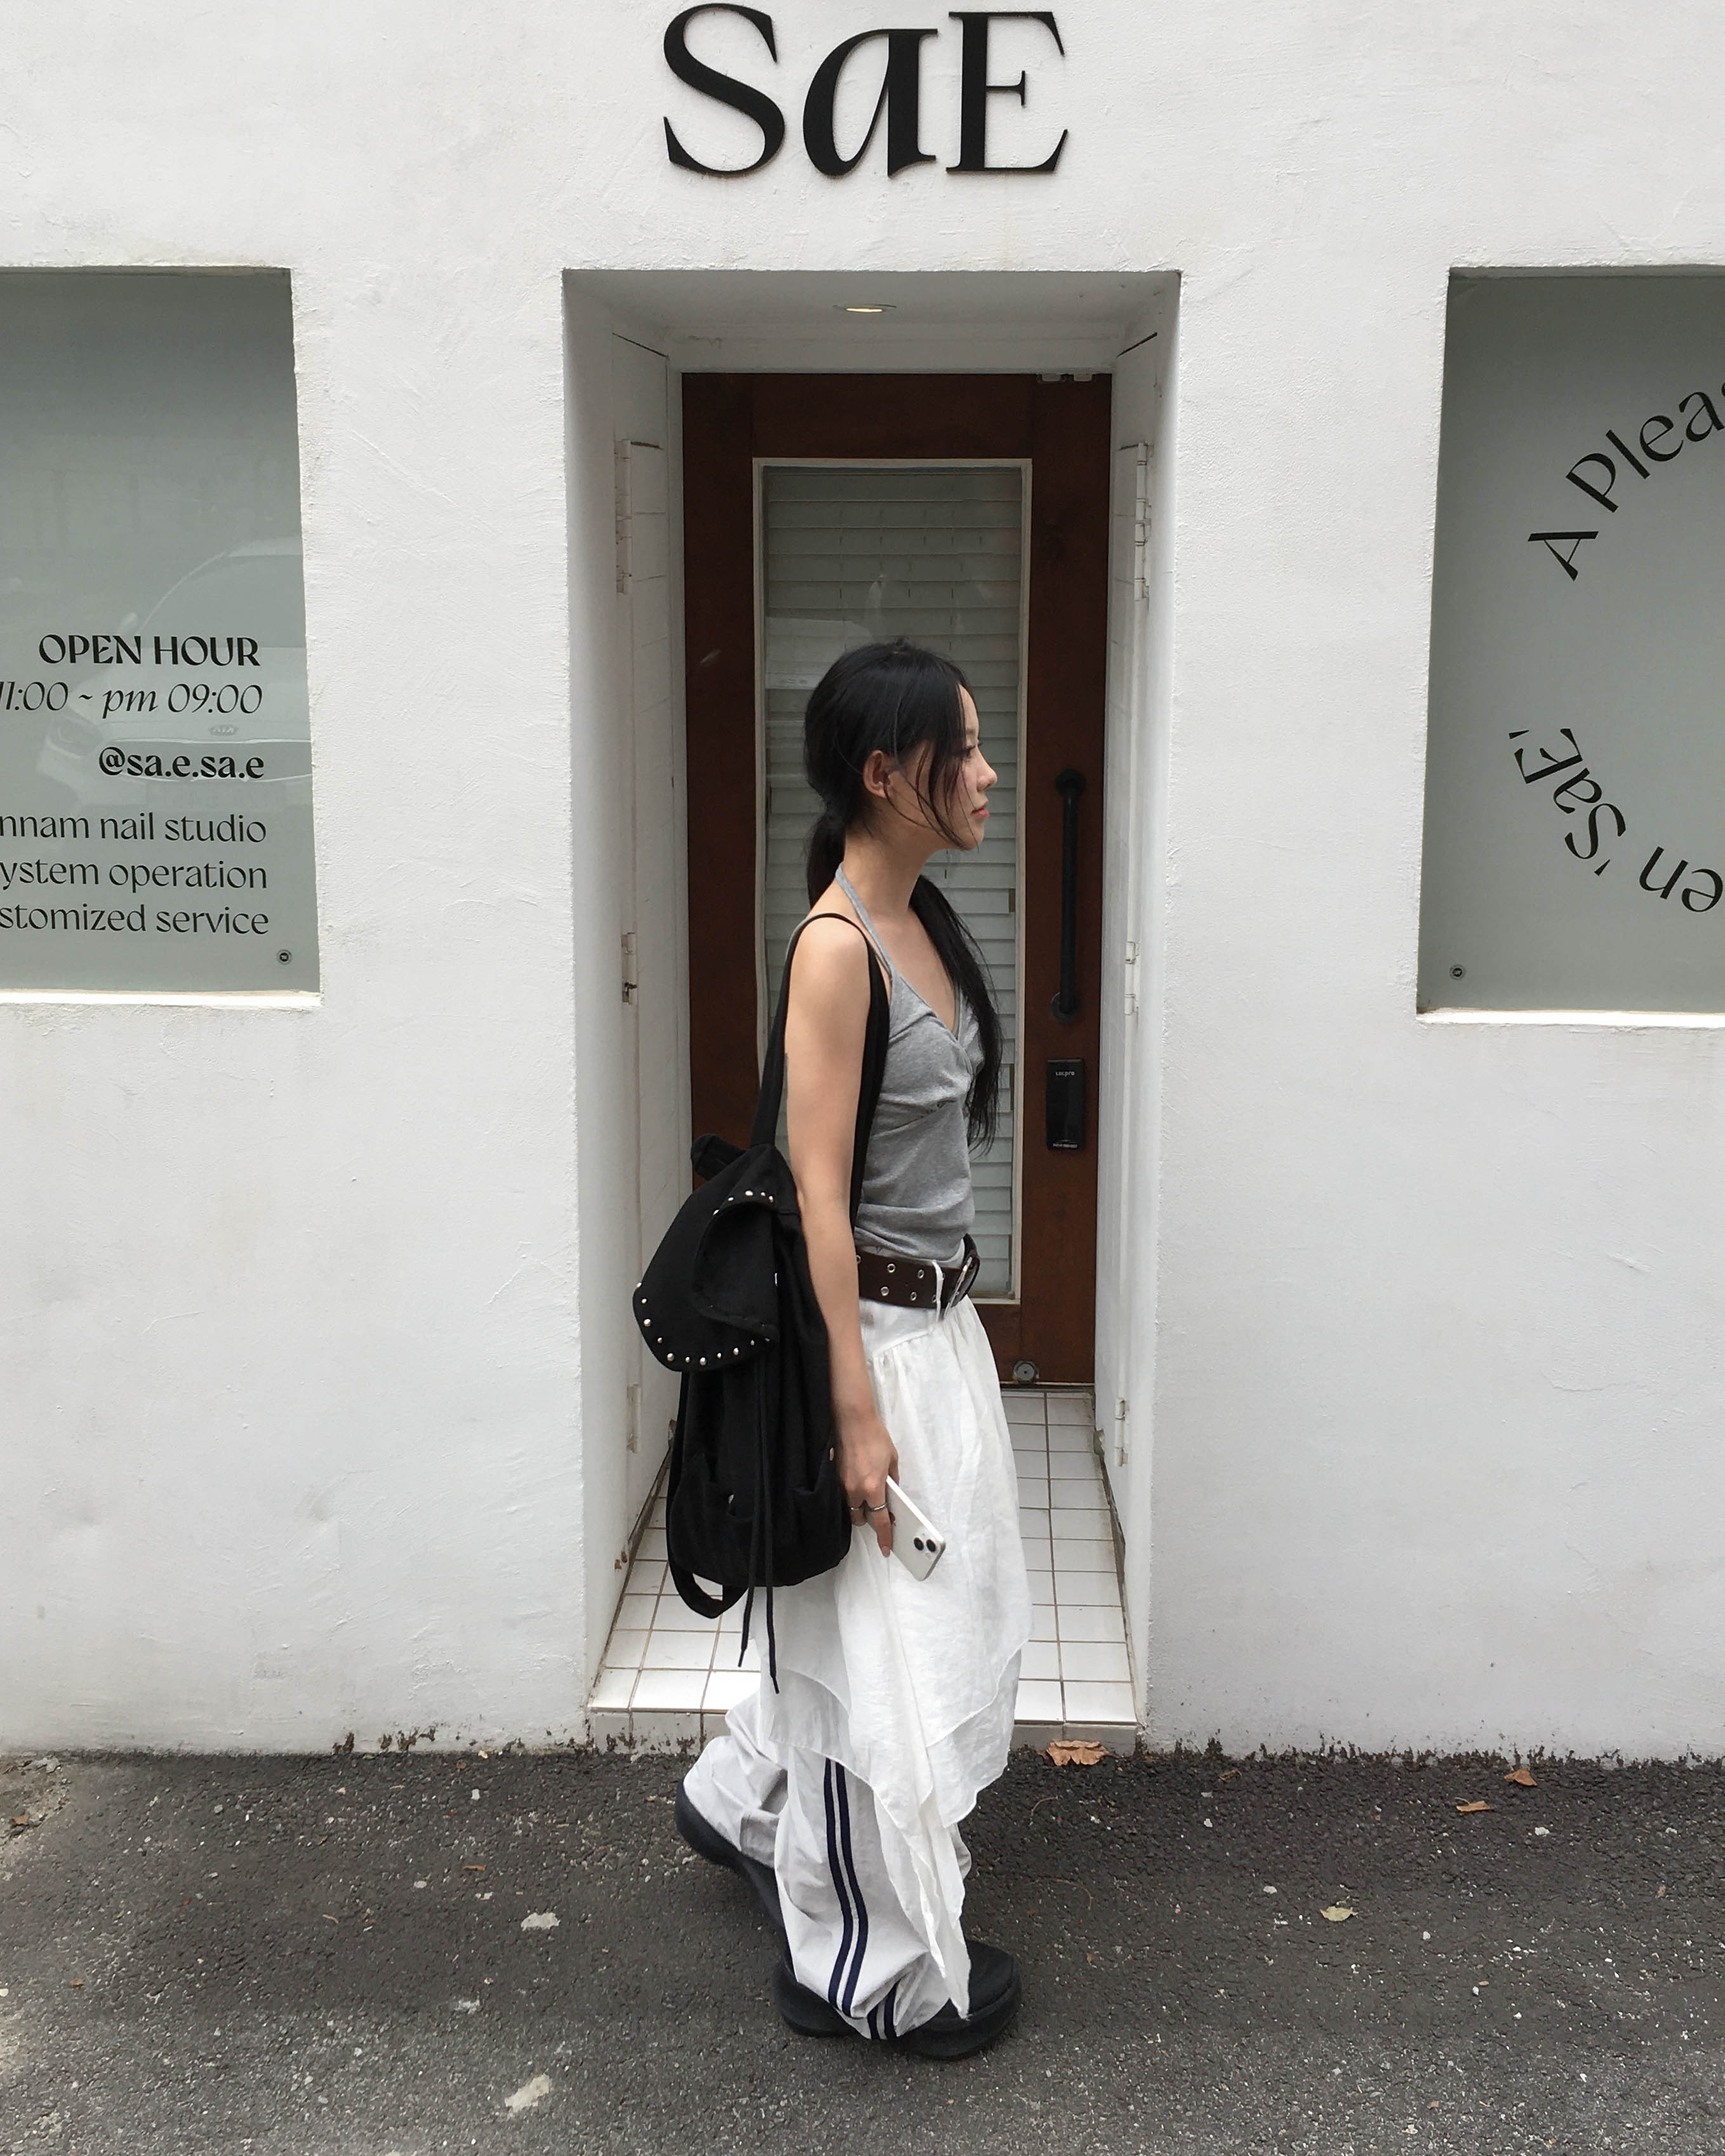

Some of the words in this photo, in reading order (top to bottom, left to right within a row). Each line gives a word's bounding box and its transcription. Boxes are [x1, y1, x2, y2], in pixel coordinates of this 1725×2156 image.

[663, 3, 1069, 178] SaE
[1528, 531, 1599, 581] A
[1566, 382, 1725, 513] Plea
[39, 634, 141, 664] OPEN
[154, 635, 260, 666] HOUR
[102, 689, 158, 719] pm
[168, 683, 262, 714] 09:00
[98, 747, 264, 779] @sa.e.sa.e
[0, 815, 90, 839] nnam
[100, 812, 154, 840] nail
[164, 814, 266, 843] studio
[0, 859, 99, 890] ystem
[109, 860, 267, 893] operation
[0, 903, 146, 932] stomized
[156, 907, 269, 935] service
